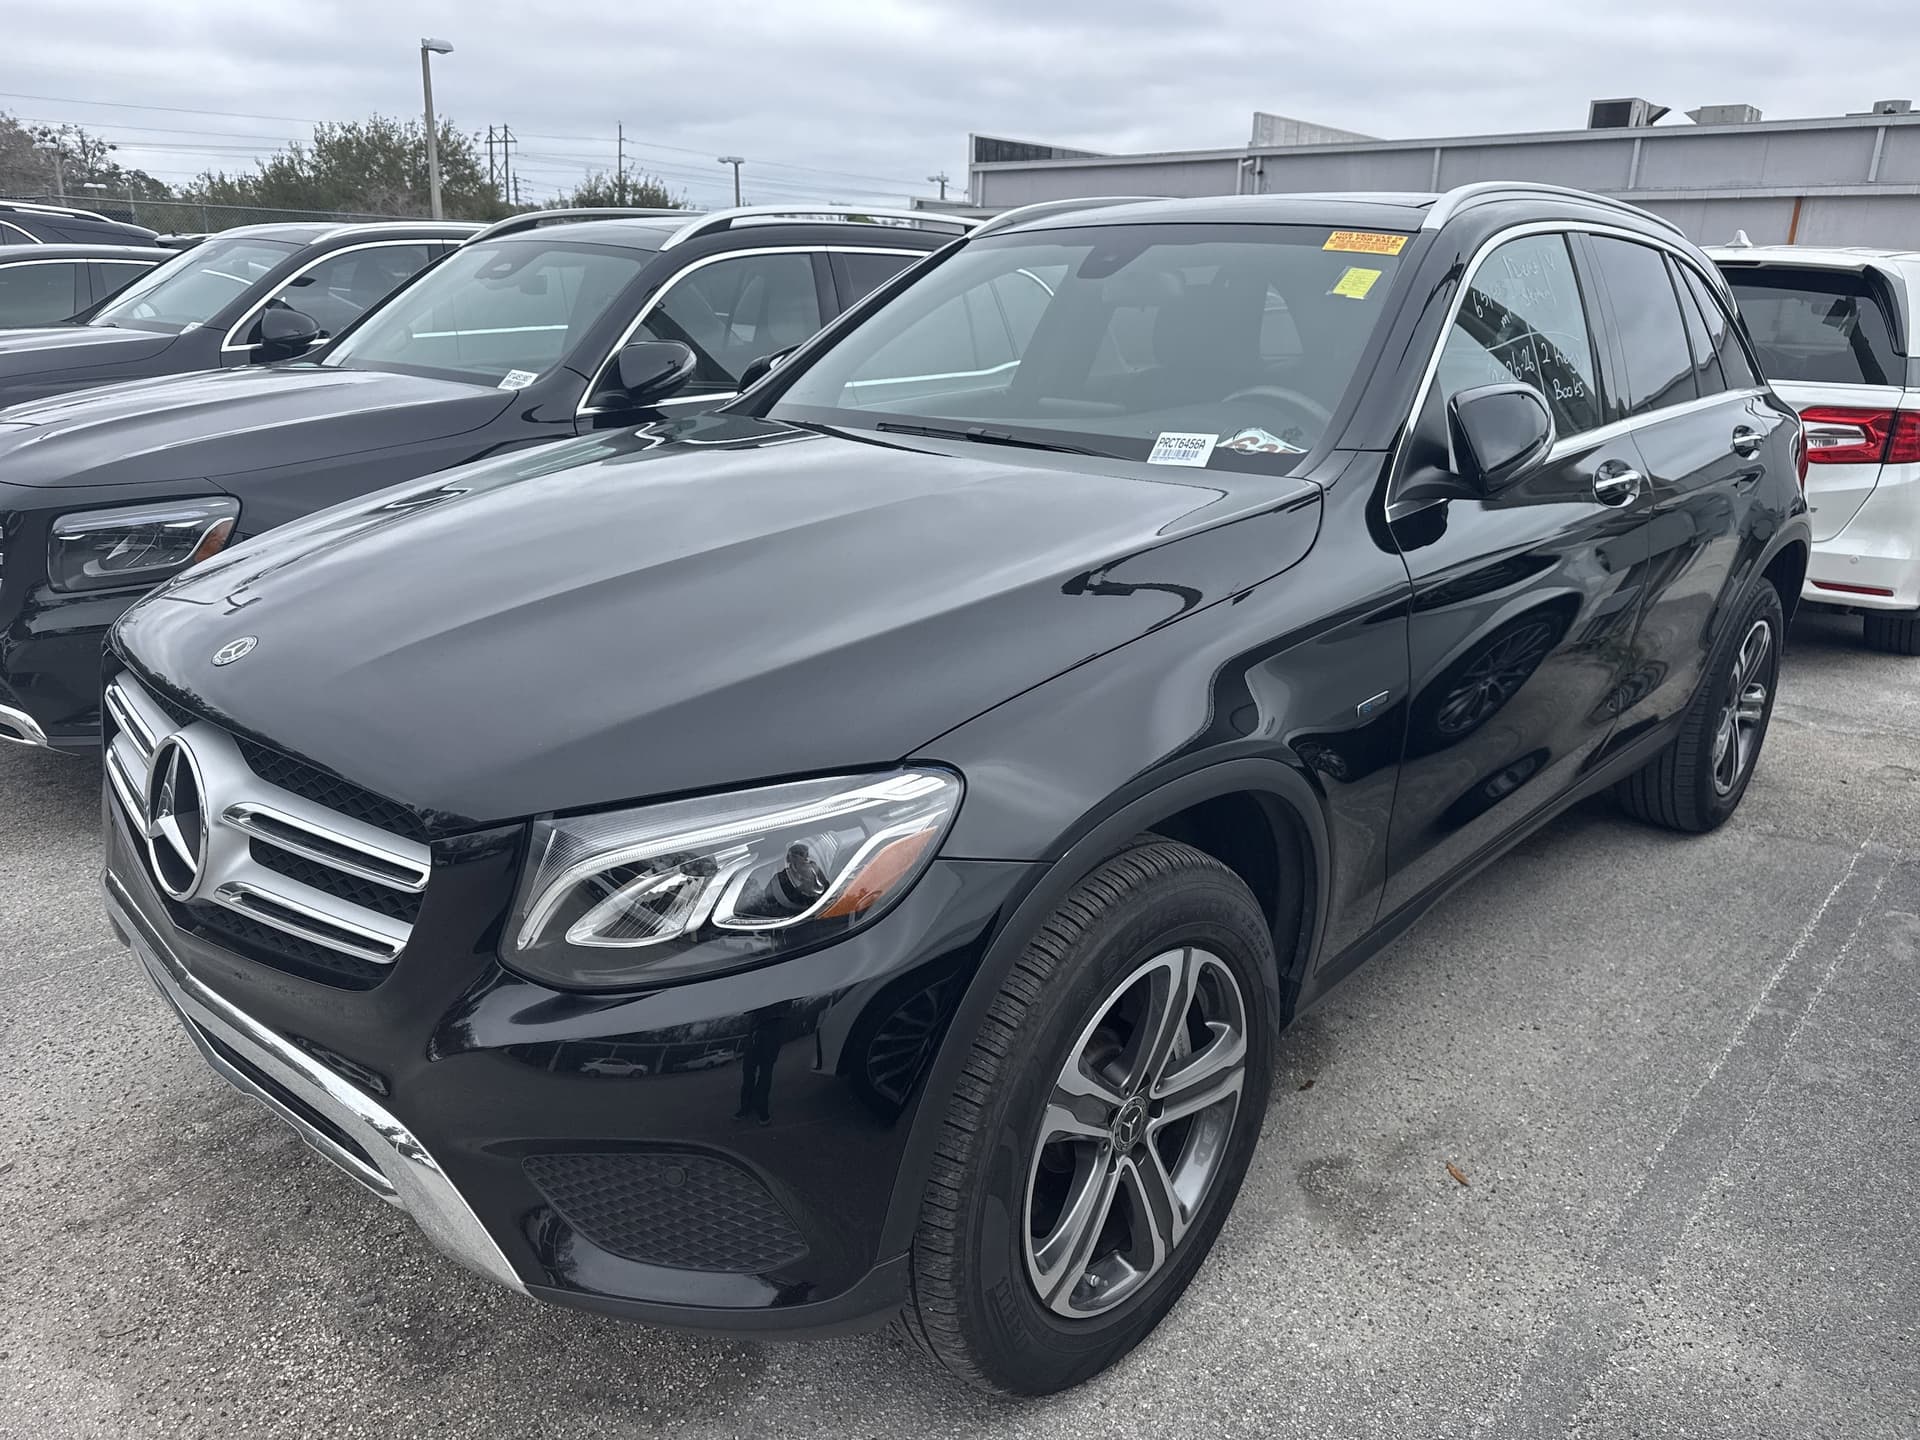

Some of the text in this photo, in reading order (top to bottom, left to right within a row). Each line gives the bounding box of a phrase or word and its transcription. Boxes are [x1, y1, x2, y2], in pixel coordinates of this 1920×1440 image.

[1541, 342, 1551, 364] 2
[1553, 377, 1584, 401] Books
[1156, 437, 1206, 450] PRCT6456A
